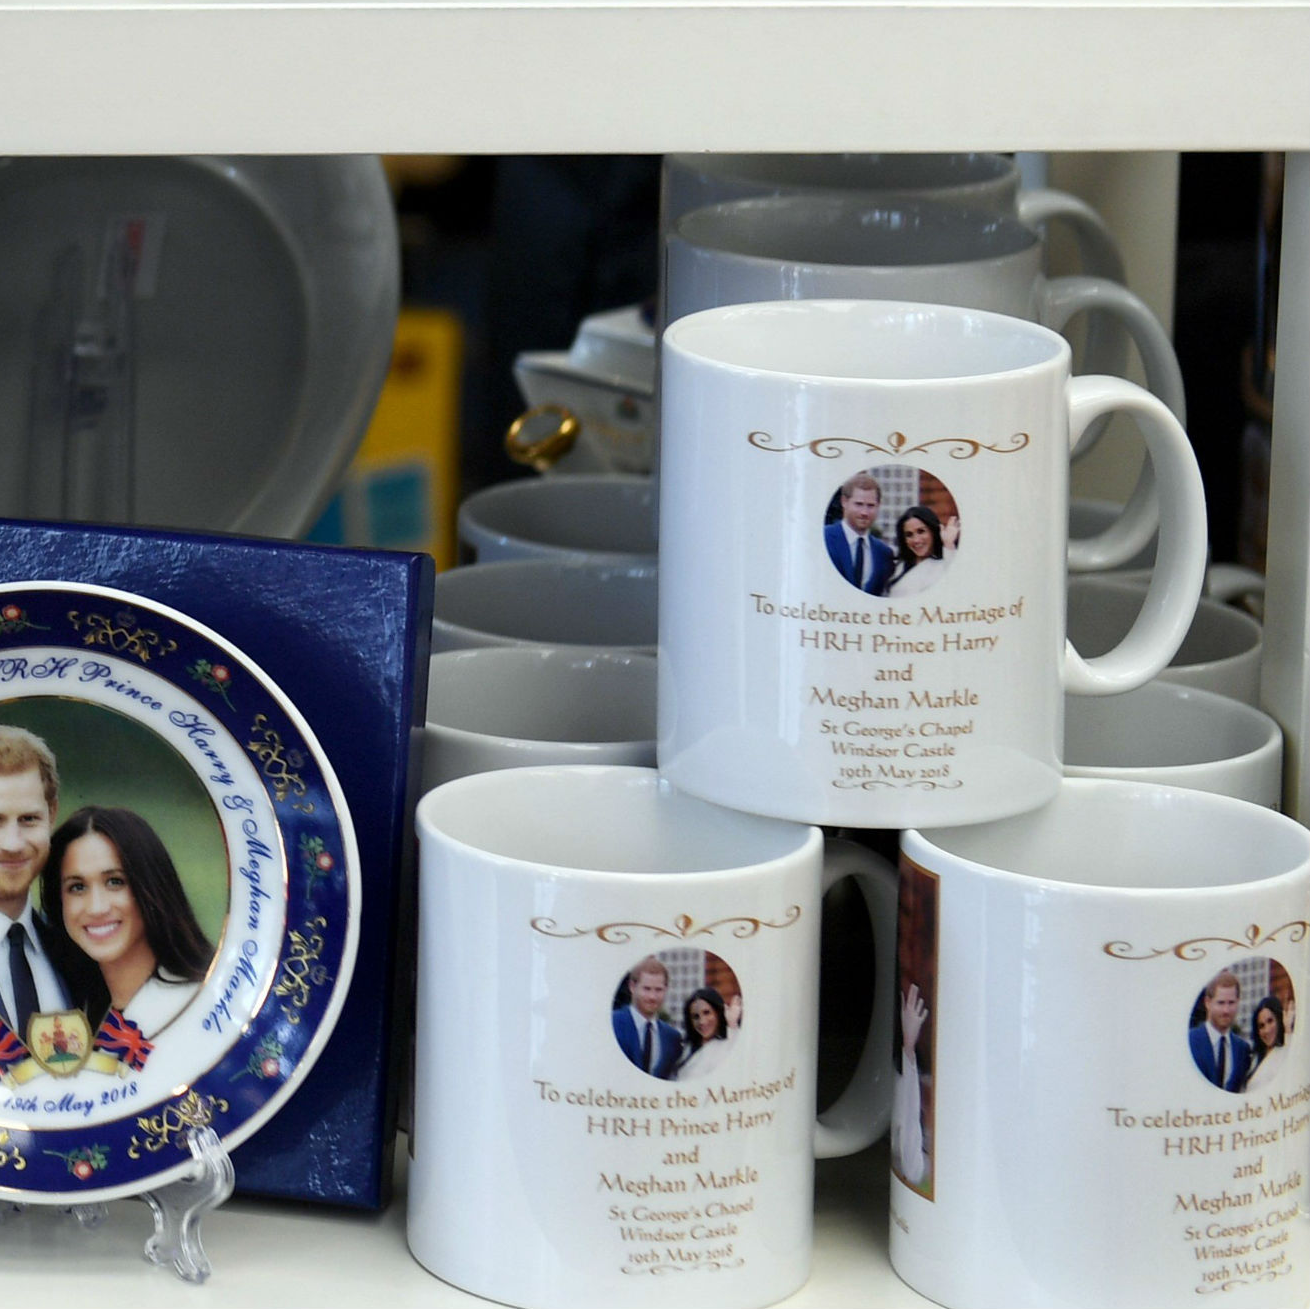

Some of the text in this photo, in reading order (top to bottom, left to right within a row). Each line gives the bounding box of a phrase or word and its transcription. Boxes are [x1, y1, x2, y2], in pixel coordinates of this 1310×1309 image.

[750, 593, 1026, 626] To celebrate the Marriage of
[799, 629, 1000, 655] HRH Prince Harry
[78, 660, 163, 711] Prince
[874, 663, 914, 682] and
[808, 686, 980, 710] Meghan Markle
[819, 719, 975, 740] St George's Chapel
[168, 710, 235, 787] Harry
[830, 741, 956, 758] Windsor Castle
[839, 764, 950, 781] 19th May 2018
[224, 794, 254, 815] &
[241, 818, 274, 931] Meghan
[201, 939, 259, 1034] Markle
[43, 1092, 95, 1117] May
[100, 1081, 139, 1105] 2018
[596, 1167, 760, 1197] Meghan Markle
[1232, 1157, 1264, 1180] and
[1172, 1172, 1302, 1216] Meghan Markle
